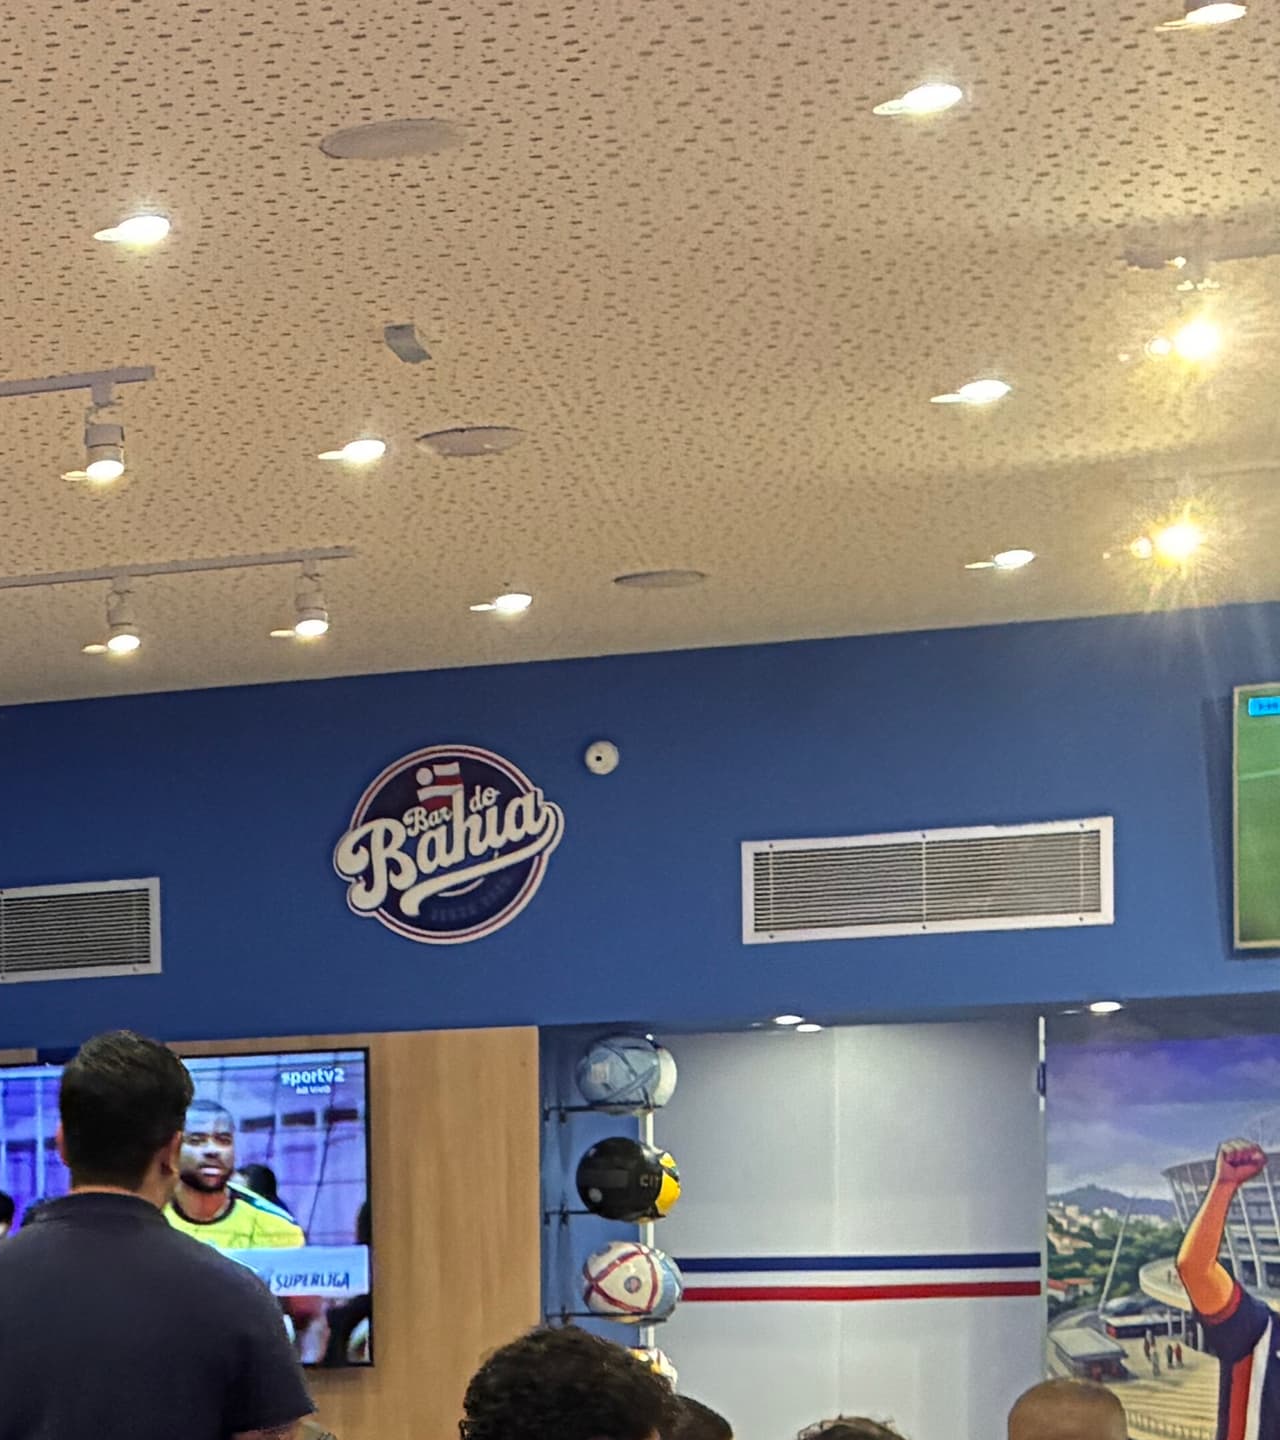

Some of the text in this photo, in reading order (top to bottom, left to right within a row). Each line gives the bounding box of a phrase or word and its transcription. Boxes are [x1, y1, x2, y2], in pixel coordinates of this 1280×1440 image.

[336, 786, 552, 912] Bahia
[402, 785, 500, 837] Bar do
